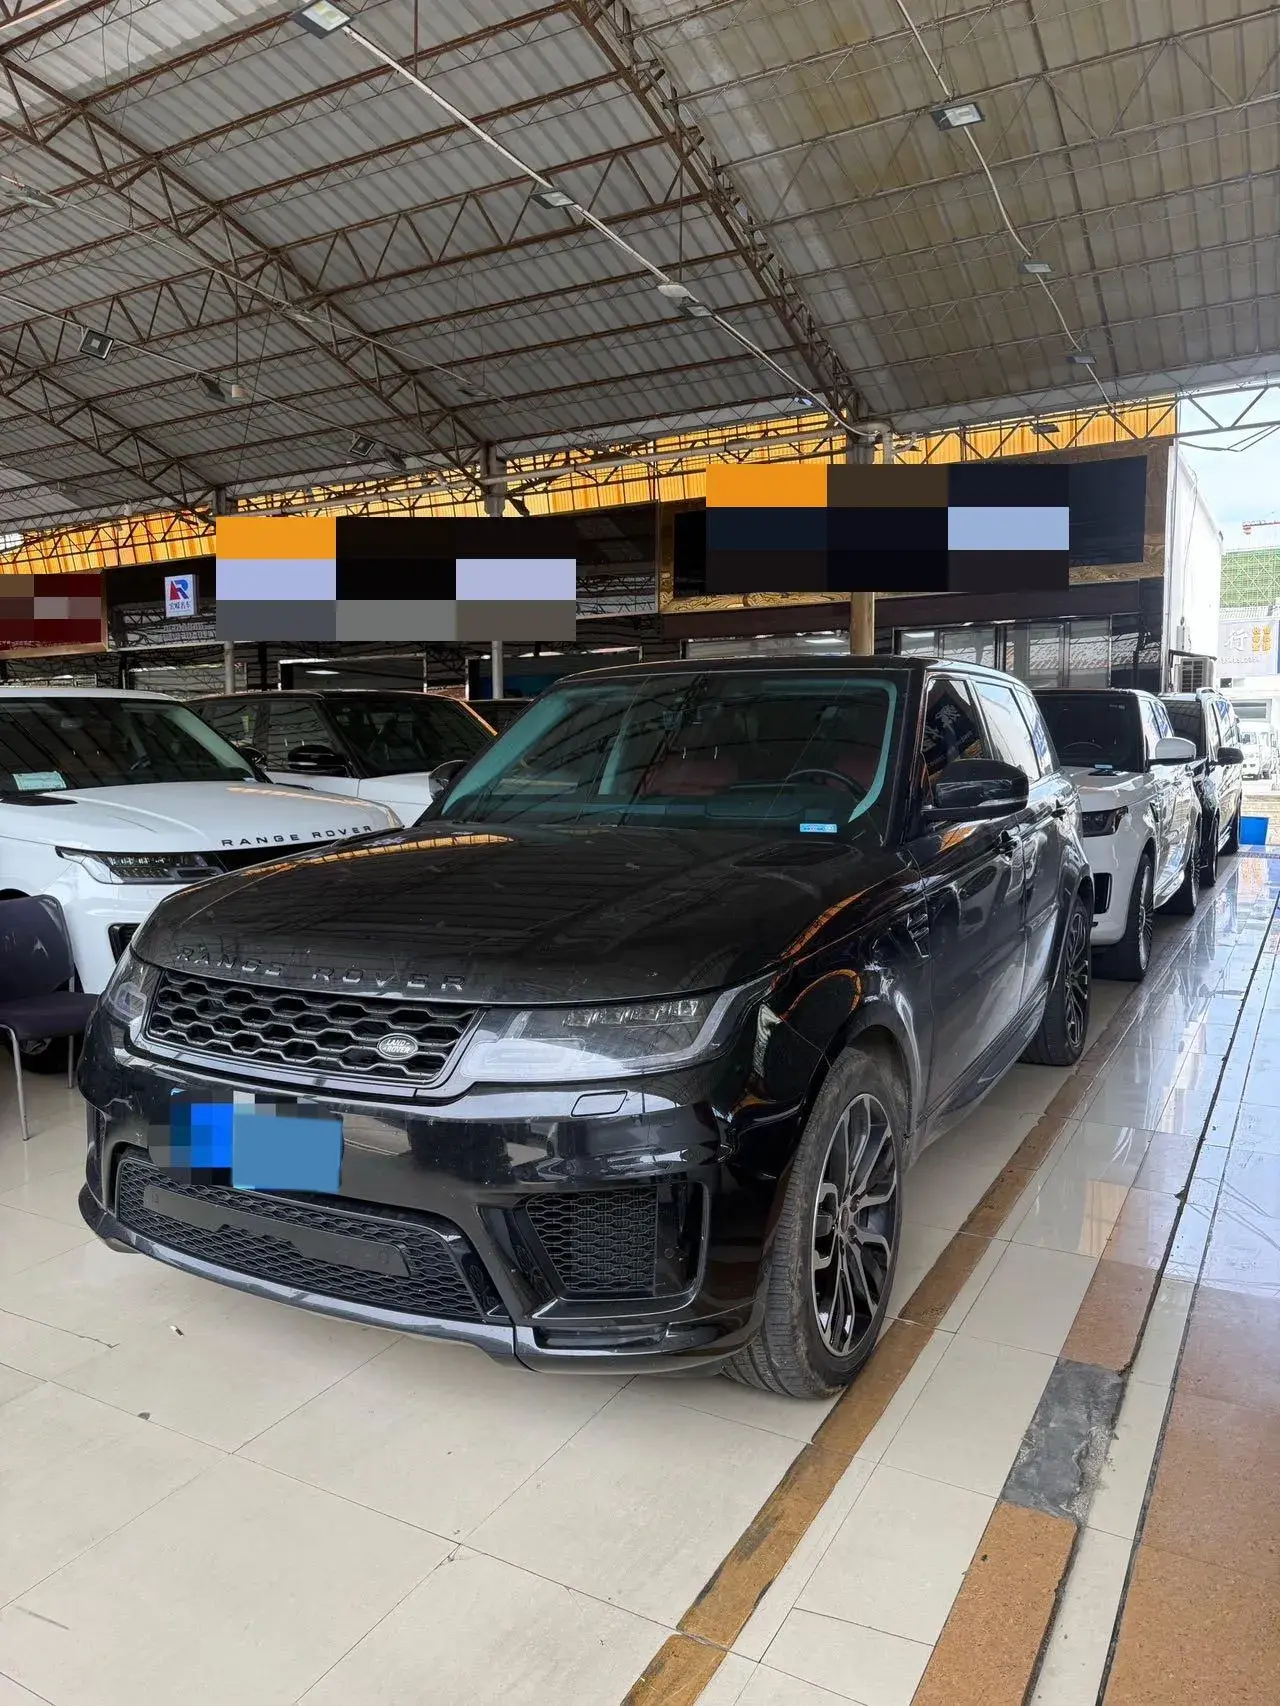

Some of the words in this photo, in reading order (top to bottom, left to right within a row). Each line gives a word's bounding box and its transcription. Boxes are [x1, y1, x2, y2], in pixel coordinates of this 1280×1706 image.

[221, 834, 300, 847] RANGE
[312, 825, 373, 839] ROVER
[176, 946, 284, 977] RANGE
[312, 966, 466, 991] ROVER
